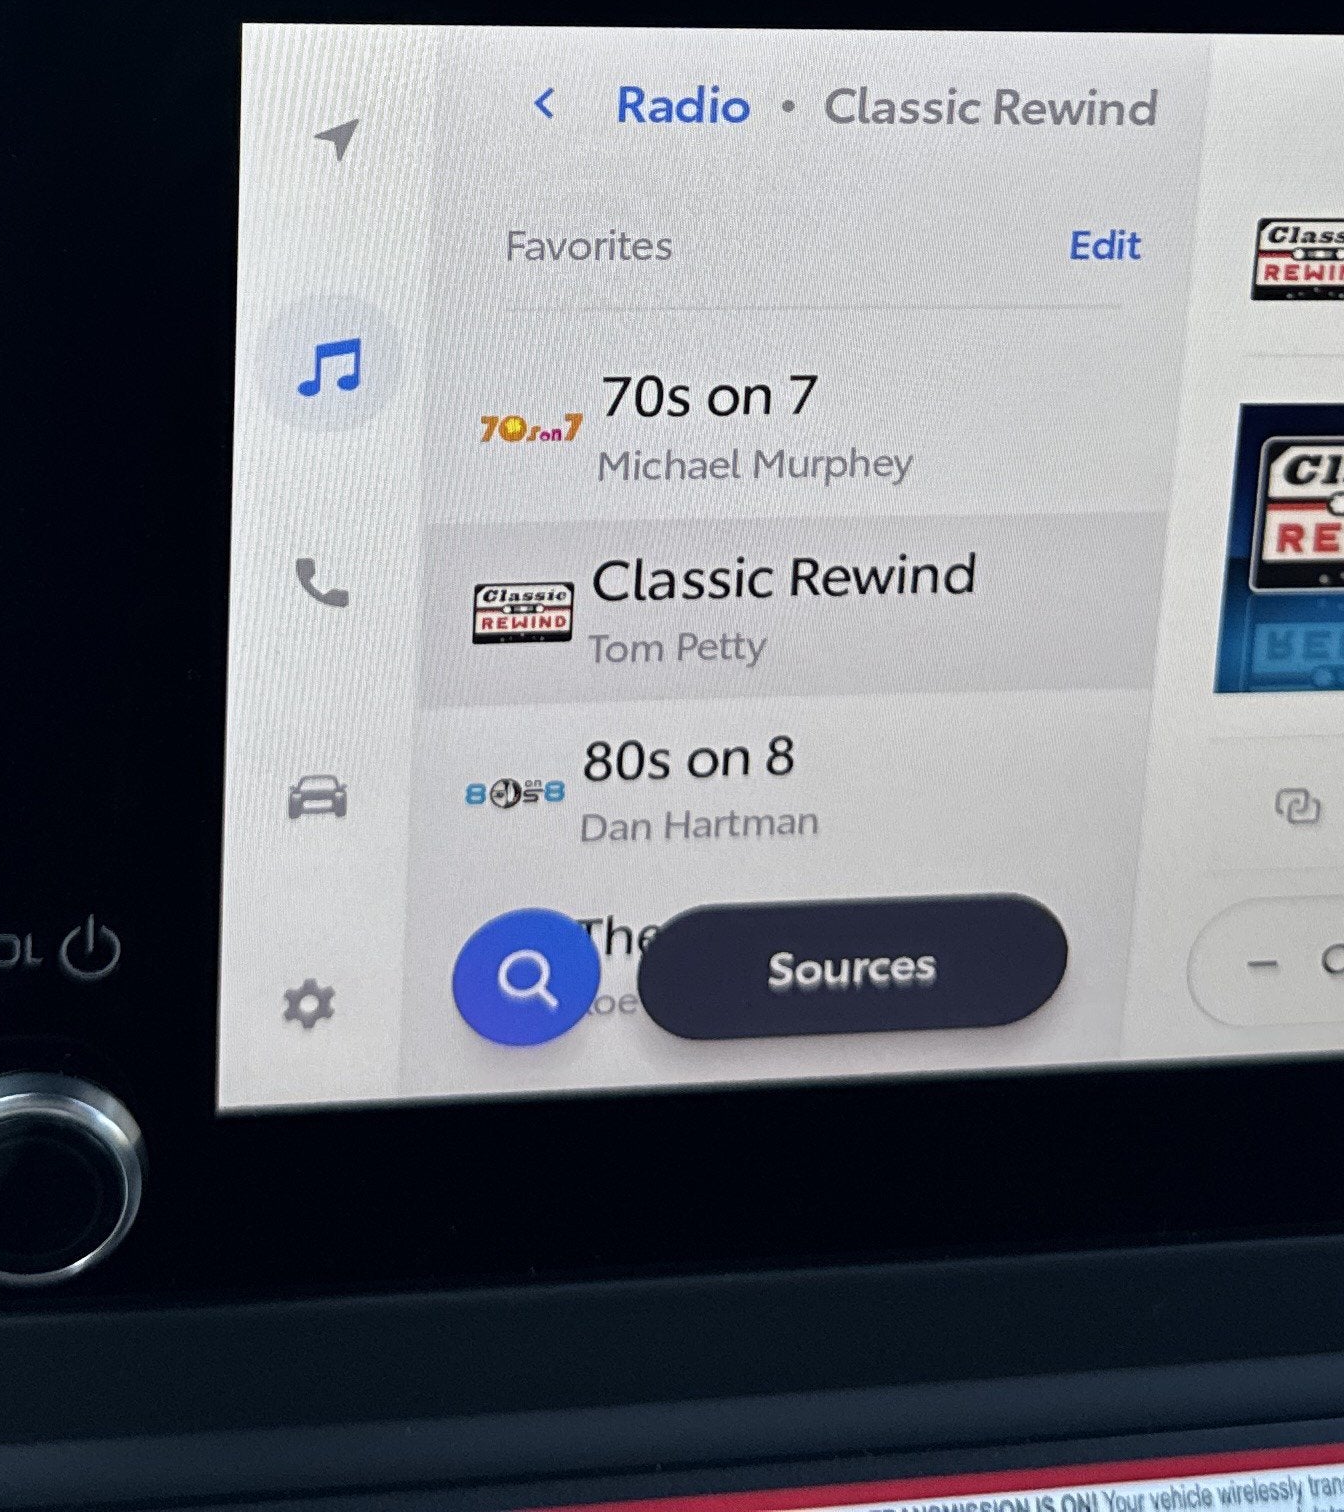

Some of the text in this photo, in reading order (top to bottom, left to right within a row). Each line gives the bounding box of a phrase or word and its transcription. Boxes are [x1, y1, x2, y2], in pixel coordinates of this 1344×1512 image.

[616, 85, 1160, 129] Radio Classic Rewind
[505, 228, 1143, 264] Favorites Edit
[602, 374, 819, 418] 70s on 7
[597, 448, 914, 487] Michael Murphey
[481, 587, 568, 603] Classic
[592, 551, 977, 602] Classic Rewind
[481, 614, 567, 632] REWIND
[588, 632, 769, 668] Tom Petty
[583, 734, 794, 782] 80s on 8
[580, 809, 820, 843] Dan Hartman
[768, 952, 936, 990] Sources
[586, 992, 638, 1016] oe
[1102, 1489, 1145, 1512] Your
[1149, 1483, 1213, 1510] vehicle
[1217, 1475, 1303, 1506] wirelessly
